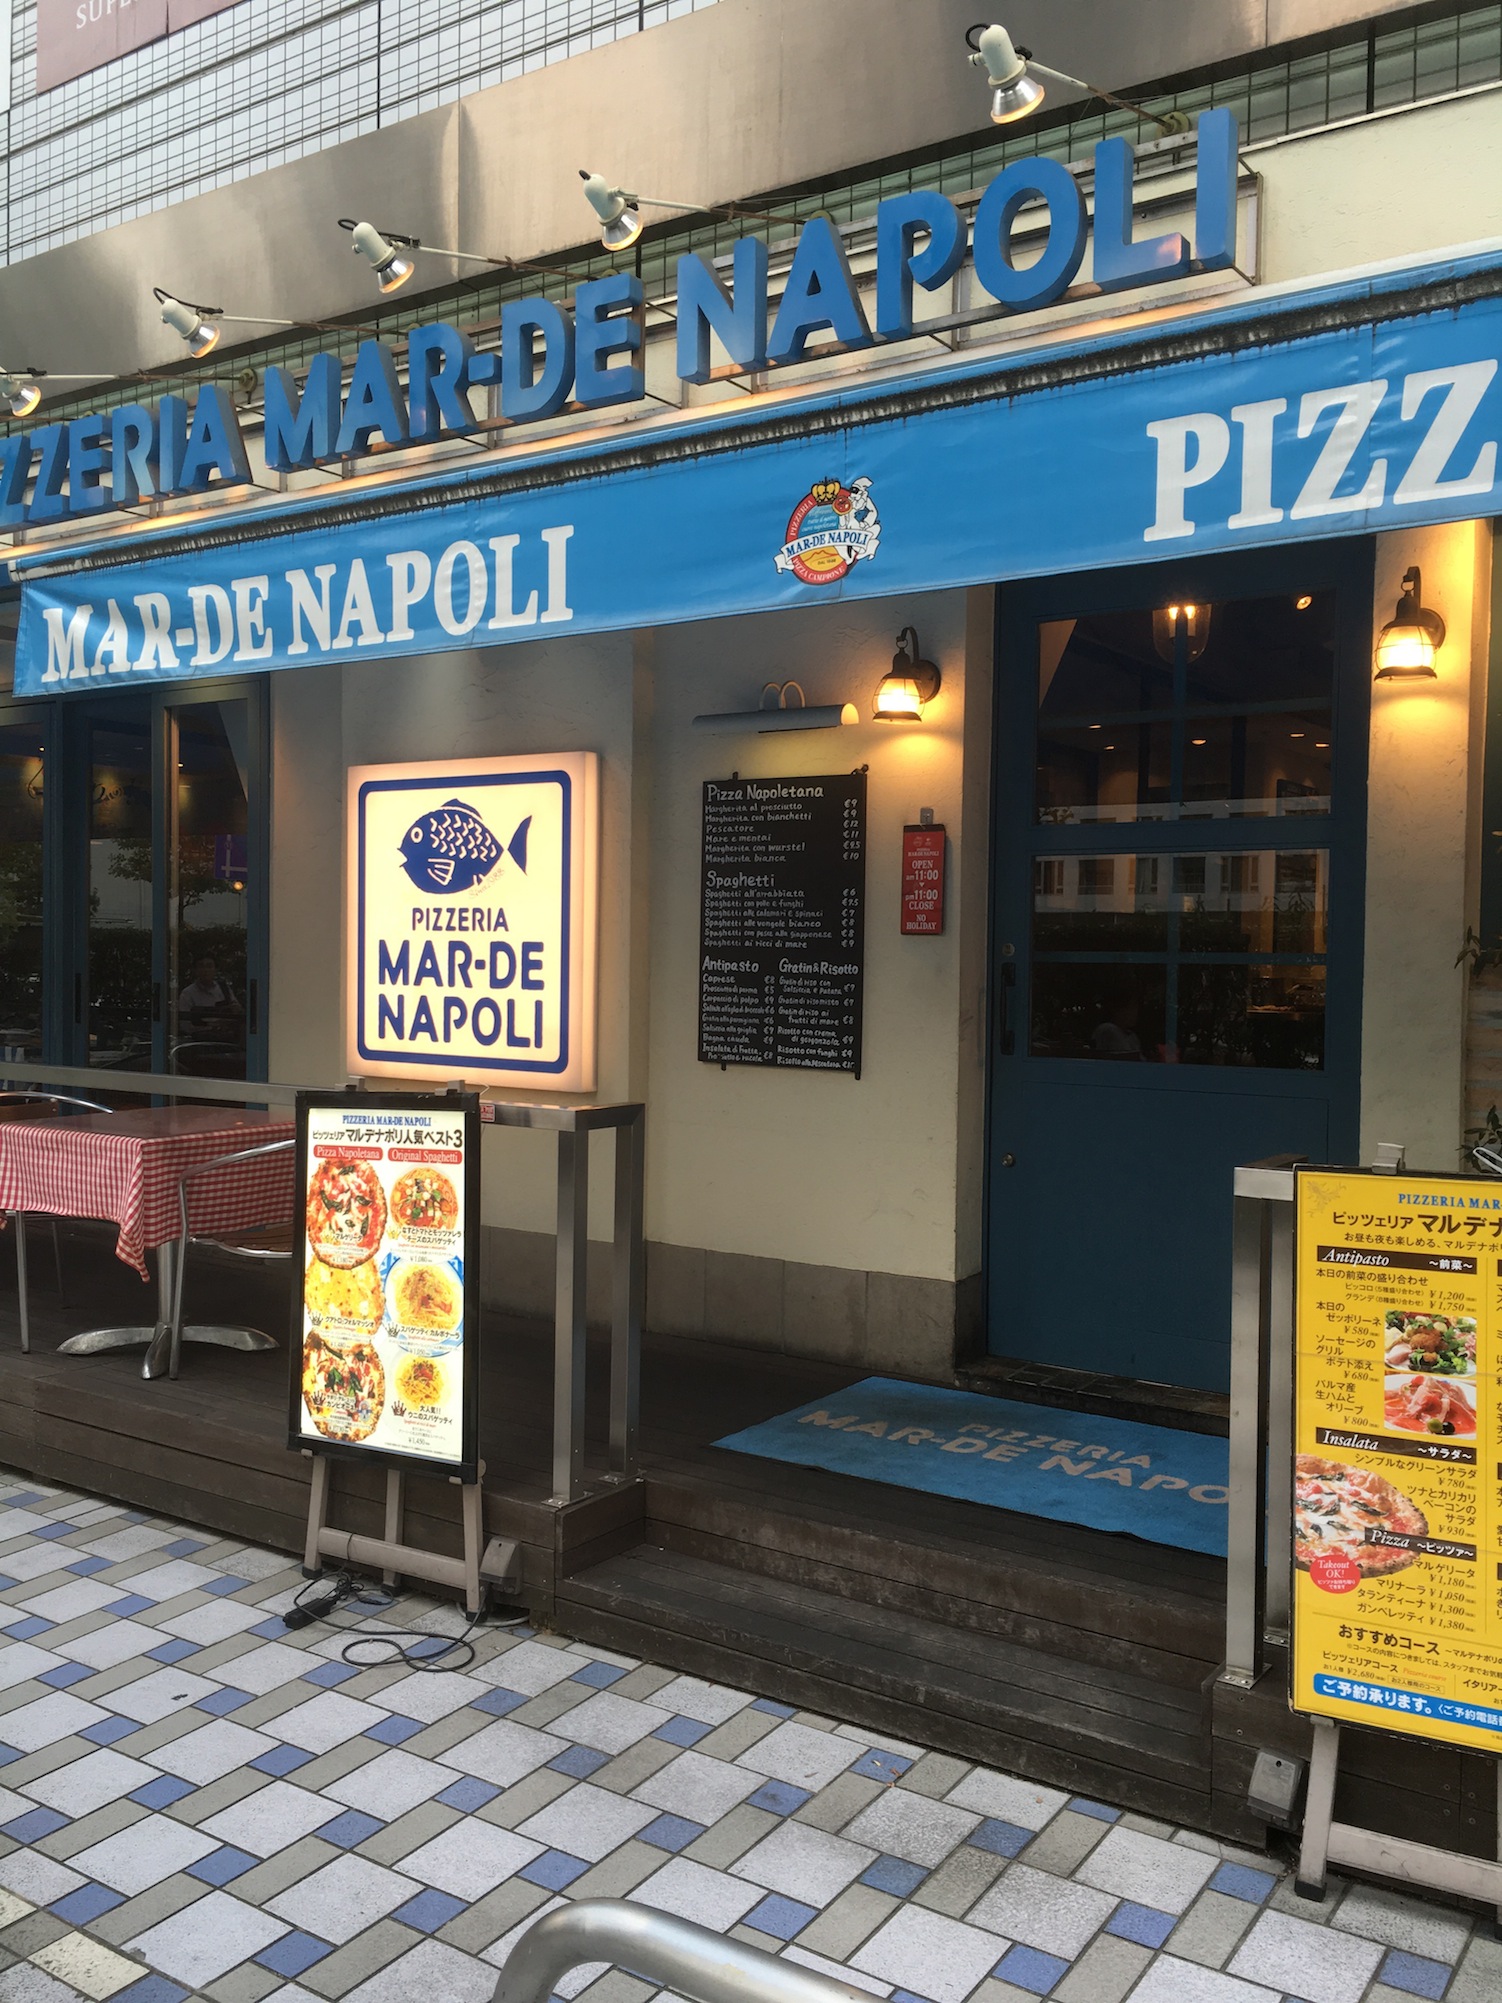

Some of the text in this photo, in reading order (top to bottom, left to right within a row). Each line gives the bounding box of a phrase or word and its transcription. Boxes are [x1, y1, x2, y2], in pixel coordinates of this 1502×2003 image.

[265, 272, 646, 473] MAR-DE
[677, 107, 1239, 384] NAPOLI
[1144, 359, 1499, 542] PIZZ
[785, 531, 869, 558] MAR-DE NAPOLI
[793, 557, 808, 577] PIZZA
[41, 525, 574, 683] MAR-DE NAPOLI
[707, 784, 824, 802] Pizza Napoletana
[705, 804, 748, 814] Margherita
[750, 803, 758, 812] al
[760, 802, 803, 813] prosciutto
[705, 815, 750, 824] Margherita
[751, 814, 764, 822] con
[767, 812, 812, 821] bianchetti
[706, 825, 754, 833] Pescatore
[705, 835, 729, 843] Mare
[739, 834, 771, 842] mentai
[705, 845, 750, 854] Margherita
[705, 854, 751, 864] Margherita
[754, 854, 786, 862] bianca
[912, 860, 934, 869] OPEN
[706, 870, 775, 888] Spaghetti
[704, 888, 742, 899] Spaghetti
[704, 899, 742, 909] Spaghetti
[909, 901, 934, 910] CLOSE
[412, 907, 509, 932] PIZZERIA
[704, 908, 742, 919] Spaghetti
[916, 914, 926, 922] NO
[704, 918, 742, 928] Spaghetti
[788, 918, 821, 927] bianco
[906, 922, 937, 930] HOLIDAY
[704, 928, 742, 939] Spaghetti
[703, 938, 742, 948] Spaghetti
[378, 939, 545, 990] MAR-DE
[702, 955, 760, 973] Antipasto
[702, 973, 735, 984] Caprese
[378, 993, 543, 1049] NAPOLI
[342, 1115, 432, 1127] PIZZERIA MAR-DE NAPOLI
[317, 1146, 380, 1160] Pizza Napoletana
[392, 1149, 458, 1164] Original Spaghetti
[1398, 1194, 1465, 1208] PIZZERIA
[1322, 1249, 1390, 1267] Antipasto
[1316, 1267, 1429, 1287] 本日の前菜の盛り合わせ
[1316, 1301, 1345, 1311] 本日の
[1315, 1334, 1376, 1349] ソーセージの
[1315, 1344, 1344, 1356] グリル
[1315, 1390, 1355, 1403] 生ハムと
[1326, 1402, 1364, 1415] オリーブ
[796, 1409, 1031, 1464] MAR-DE
[1323, 1431, 1379, 1451] Insalata
[958, 1421, 1152, 1468] PIZZERIA
[1355, 1453, 1477, 1479] シンプルなグリーンサラダ
[1407, 1485, 1476, 1503] ツナとカリカリ
[1445, 1513, 1476, 1526] サラダ
[1370, 1530, 1410, 1548] Pizza
[1317, 1560, 1350, 1569] Takeout
[1414, 1559, 1475, 1578] マルゲリータ
[1326, 1569, 1345, 1578] OK!
[1376, 1578, 1426, 1595] マリナーラ
[1357, 1588, 1426, 1609] タランティーナ
[1338, 1624, 1440, 1656] おすすめコース
[1322, 1678, 1432, 1715] ご予約承ります。
